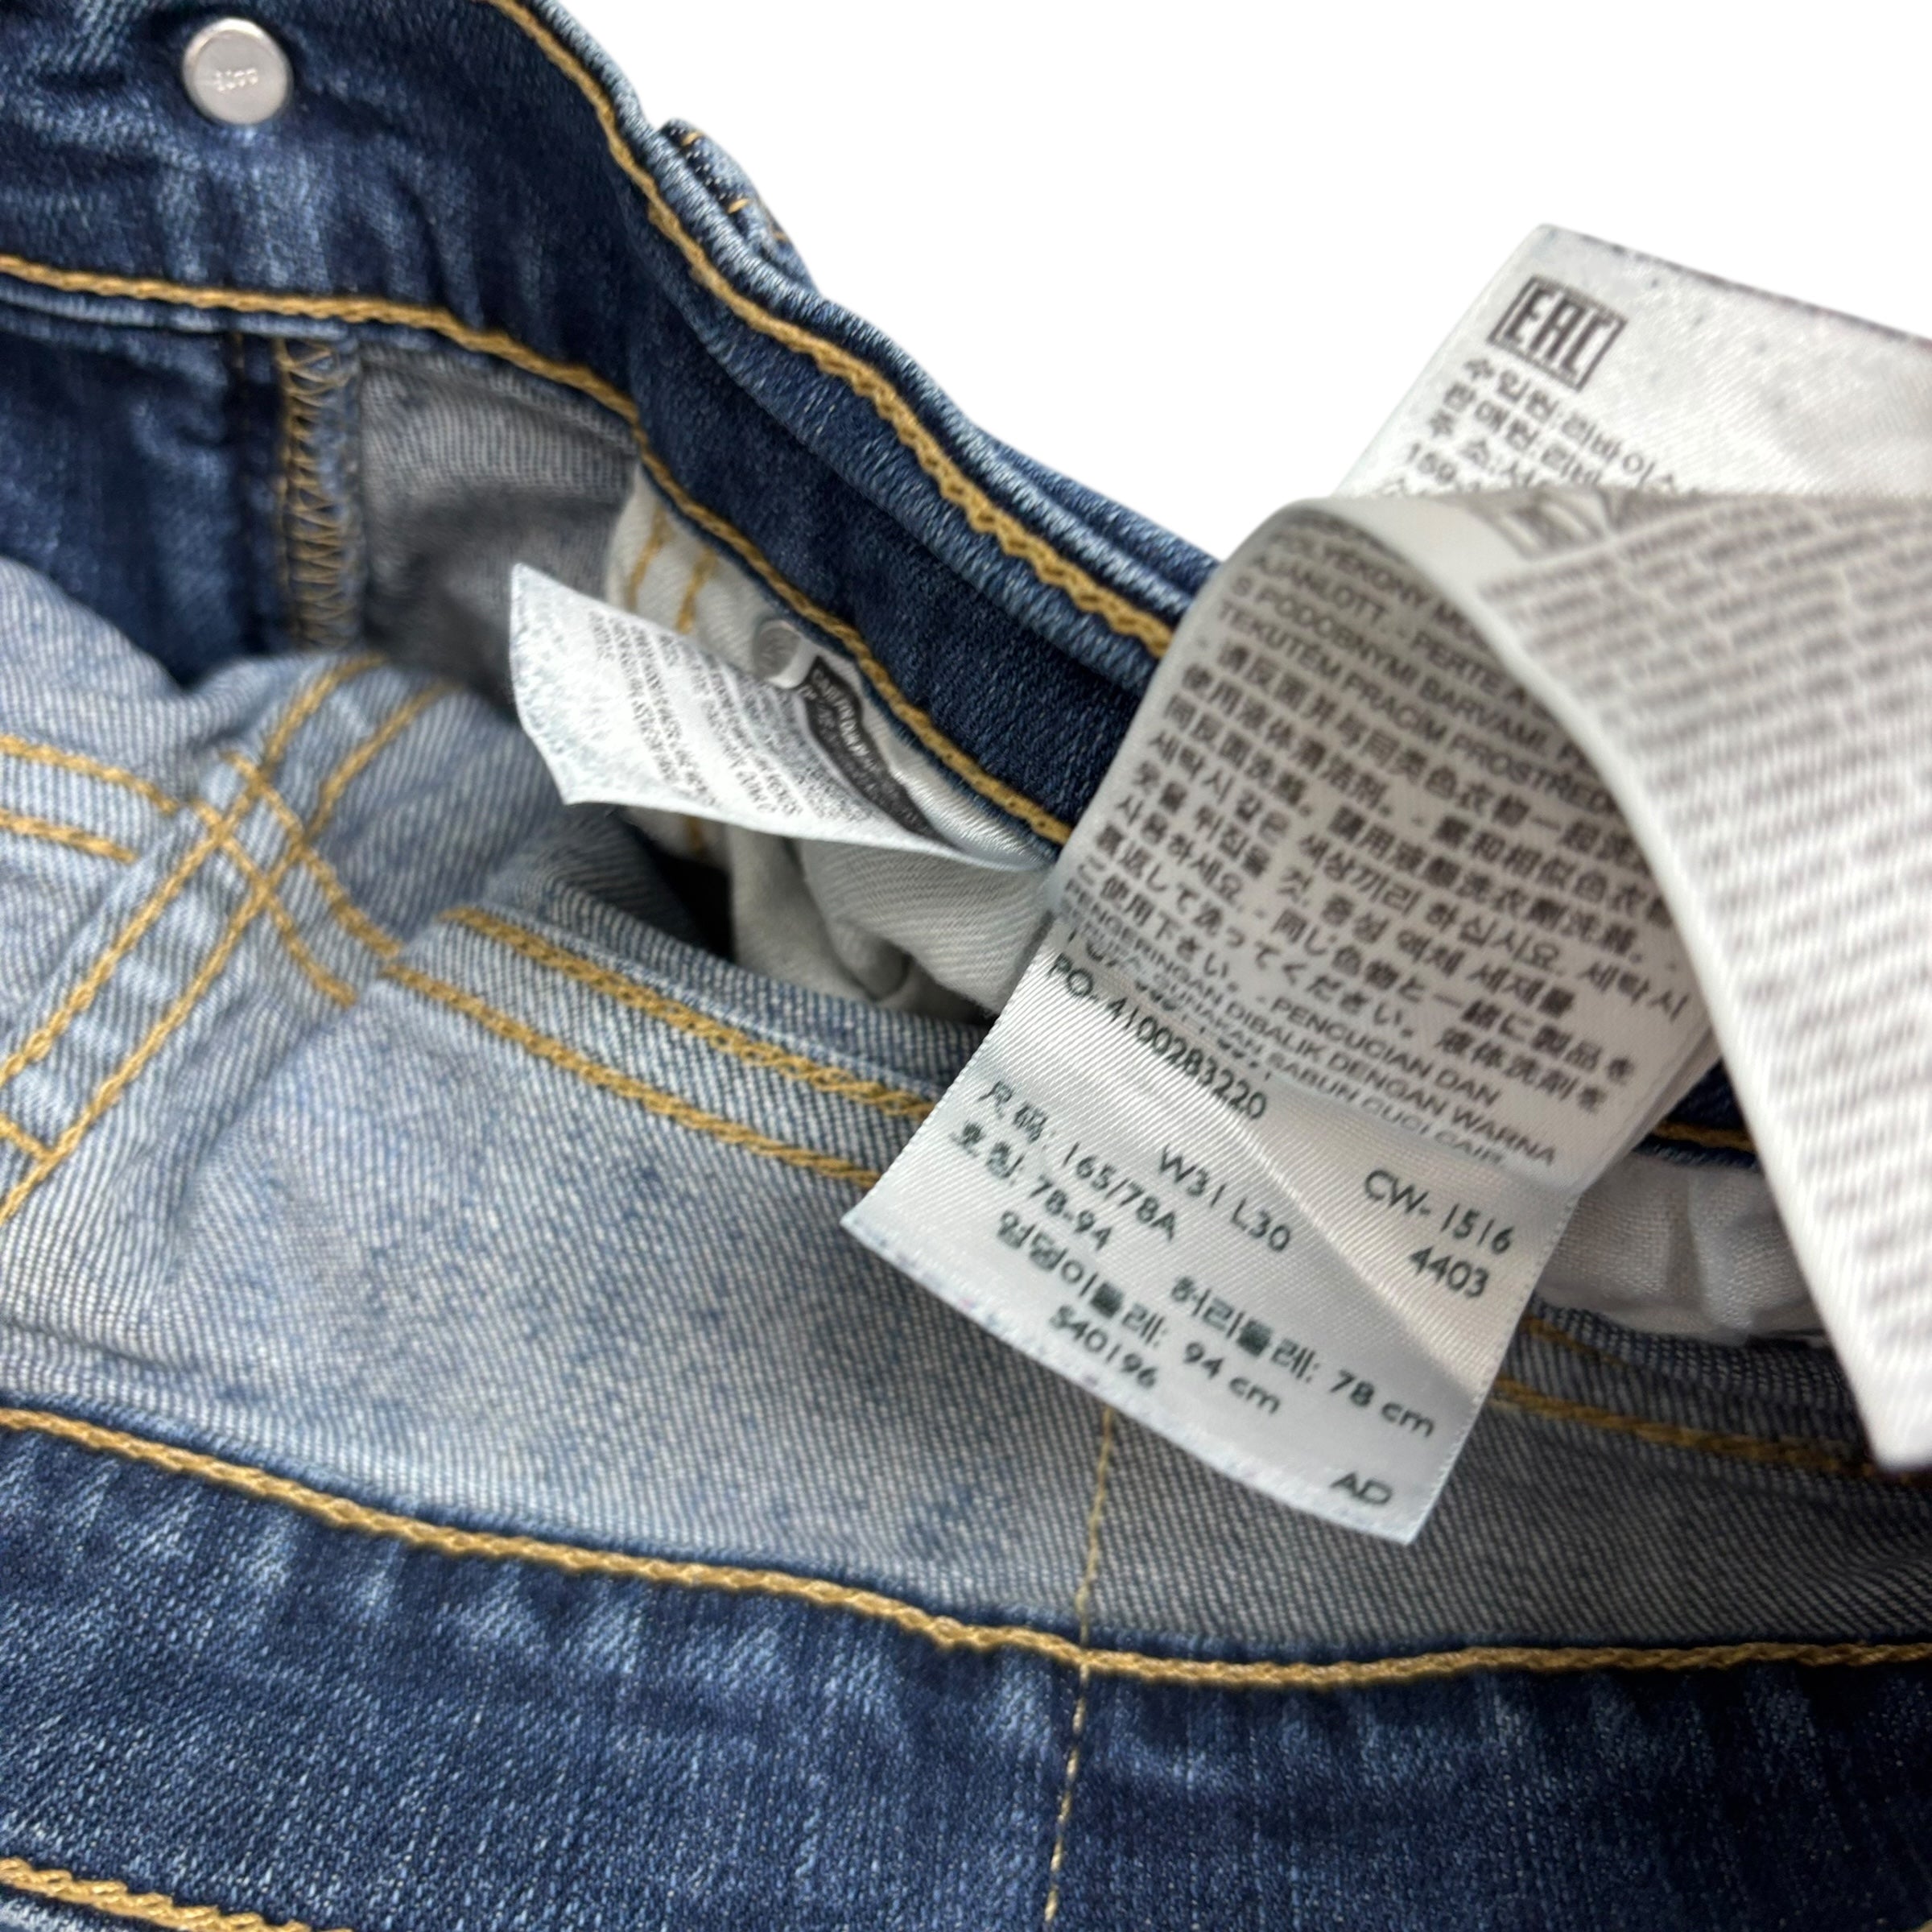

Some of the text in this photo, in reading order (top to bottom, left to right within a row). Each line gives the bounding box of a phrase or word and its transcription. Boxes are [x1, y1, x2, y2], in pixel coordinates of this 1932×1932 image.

[1504, 287, 1608, 376] EAC
[1219, 600, 1342, 681] TEKUTÉM
[1257, 587, 1418, 686] PODOBNYMI
[1105, 996, 1268, 1121] 4100283220
[1225, 1001, 1323, 1061] DIBALIK
[1327, 1052, 1448, 1117] DENGAN
[1451, 1108, 1556, 1166] WARNA
[1270, 996, 1433, 1079] PENCUCIAN
[1435, 1068, 1501, 1107] DAN
[1029, 1174, 1113, 1251] 78-94
[1063, 1141, 1176, 1242] 165/78A
[1158, 1144, 1292, 1253] W31 L30
[1363, 1168, 1515, 1255] CW- 1516
[1409, 1246, 1490, 1298] 4403
[1183, 1342, 1224, 1379] 94
[1228, 1377, 1282, 1415] cm
[1330, 1369, 1375, 1408] 78
[1381, 1402, 1435, 1438] cm
[1329, 1472, 1393, 1506] AD
